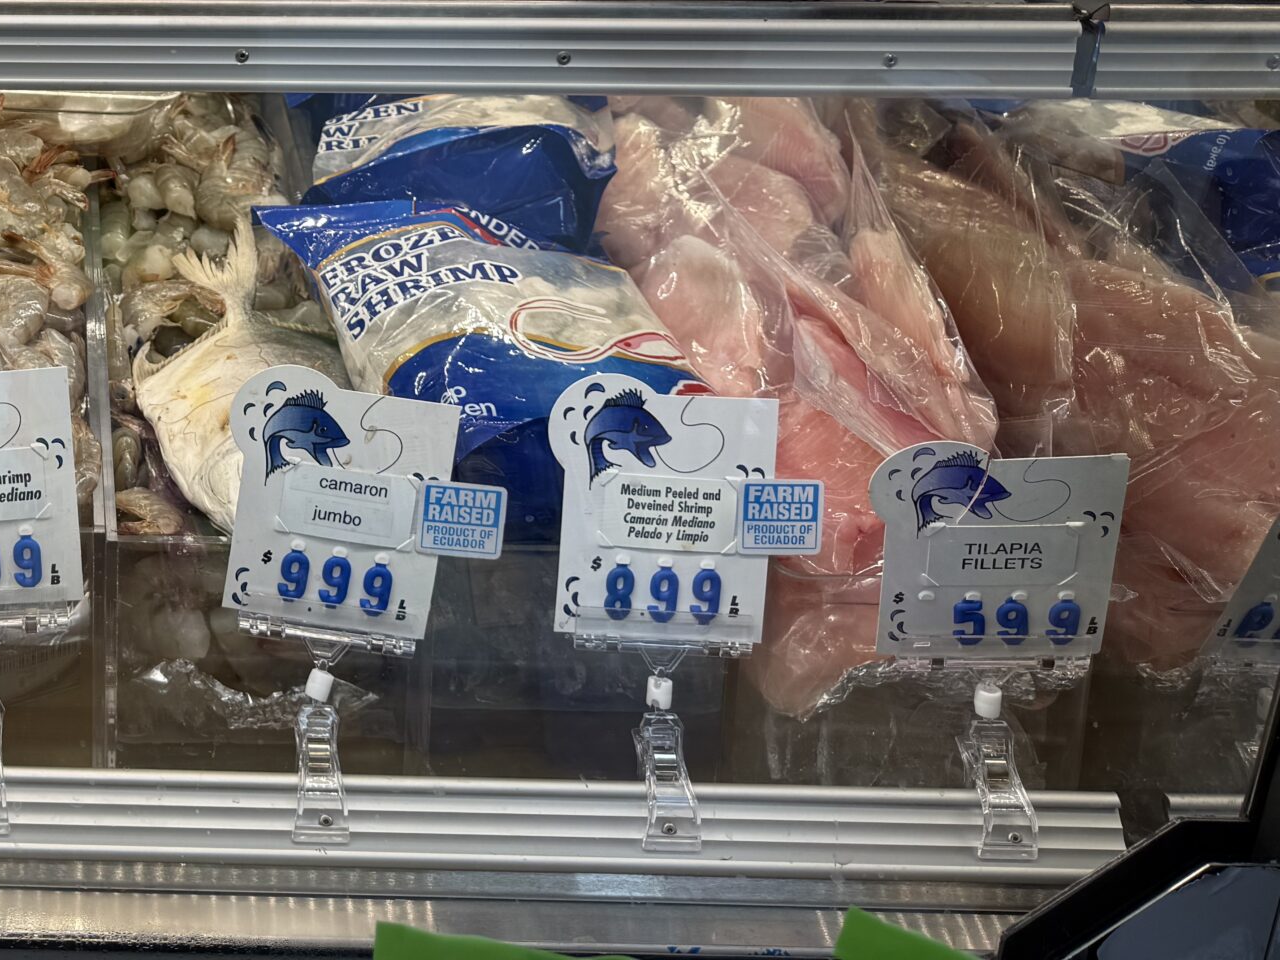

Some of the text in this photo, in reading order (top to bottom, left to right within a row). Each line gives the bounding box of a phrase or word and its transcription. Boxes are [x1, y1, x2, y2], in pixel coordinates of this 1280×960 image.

[332, 250, 429, 318] RAW
[347, 261, 521, 341] SHRIMP
[319, 477, 388, 499] camaron
[620, 484, 721, 501] Medium Peeled and
[748, 485, 814, 503] FARM
[429, 487, 496, 509] FARM
[627, 498, 713, 515] Deveined Shrimp
[311, 505, 362, 527] jumbo
[427, 503, 495, 525] RAISED
[748, 502, 813, 521] RAISED
[623, 512, 716, 529] Camarón Mediano
[747, 524, 813, 534] PRODUCT OF
[426, 525, 494, 539] PRODUCT OF
[627, 526, 709, 544] Pelado y Limpio
[754, 535, 806, 545] ECUADOR
[432, 536, 486, 550] ECUADOR
[964, 542, 1042, 555] TILAPIA
[961, 558, 1042, 570] FILLETS
